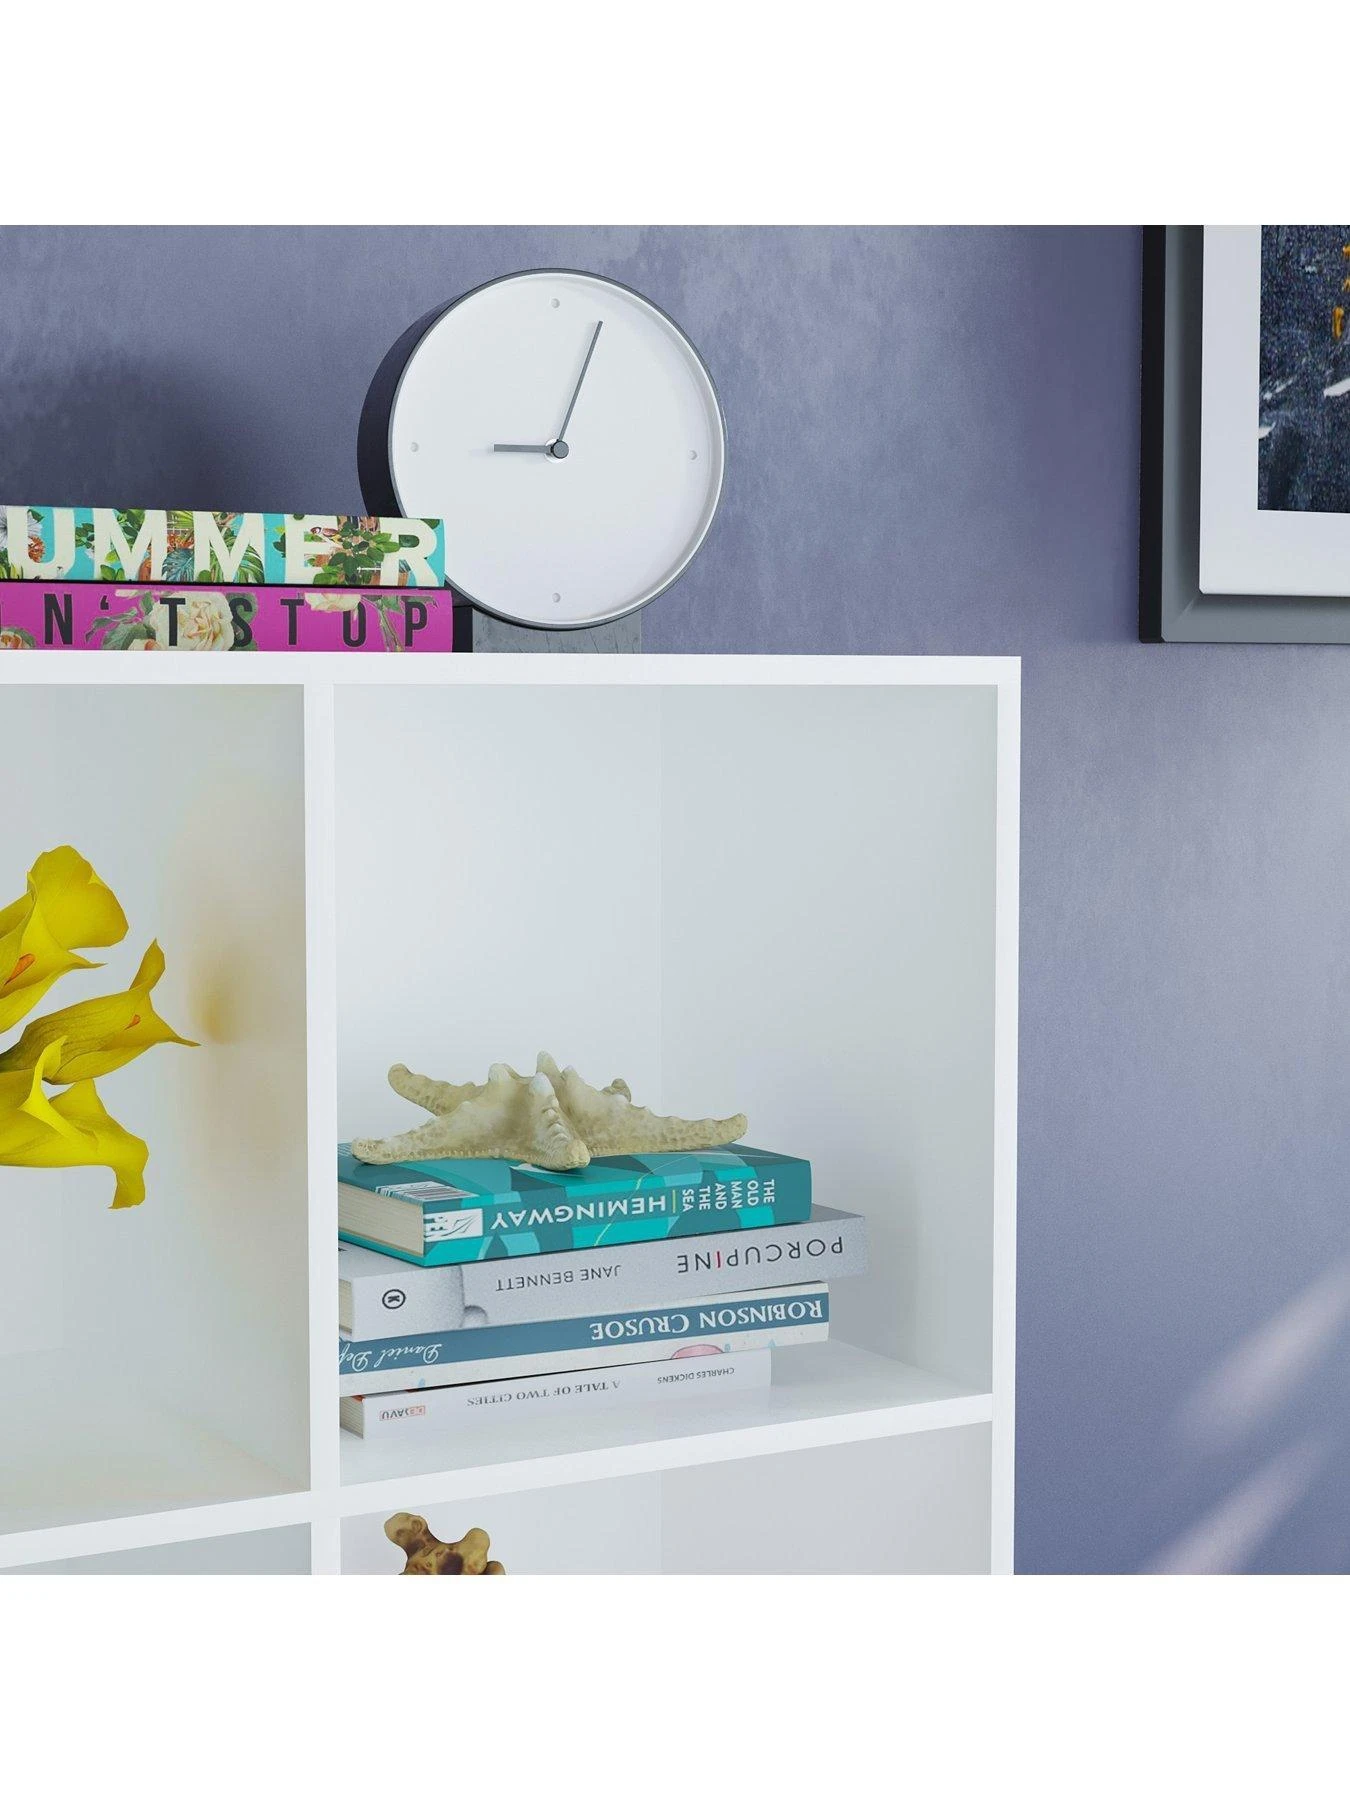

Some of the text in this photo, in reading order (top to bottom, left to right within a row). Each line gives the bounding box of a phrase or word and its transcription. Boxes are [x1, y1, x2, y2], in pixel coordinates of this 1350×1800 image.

[682, 1189, 694, 1212] SEA
[699, 1186, 711, 1210] THE
[715, 1183, 727, 1210] AND
[731, 1181, 743, 1209] MAN
[747, 1180, 759, 1206] OLD
[763, 1179, 775, 1203] THE
[490, 1195, 666, 1230] HEMINGWAY
[677, 1236, 843, 1273] PORCUPINE
[495, 1264, 621, 1292] JANE BENNETT
[590, 1300, 823, 1341] ROBINSON CRUSOE
[373, 1343, 442, 1368] Daniel
[657, 1367, 735, 1385] CHARLES DICKENS
[466, 1380, 621, 1407] A TALE OF TWO CITIES
